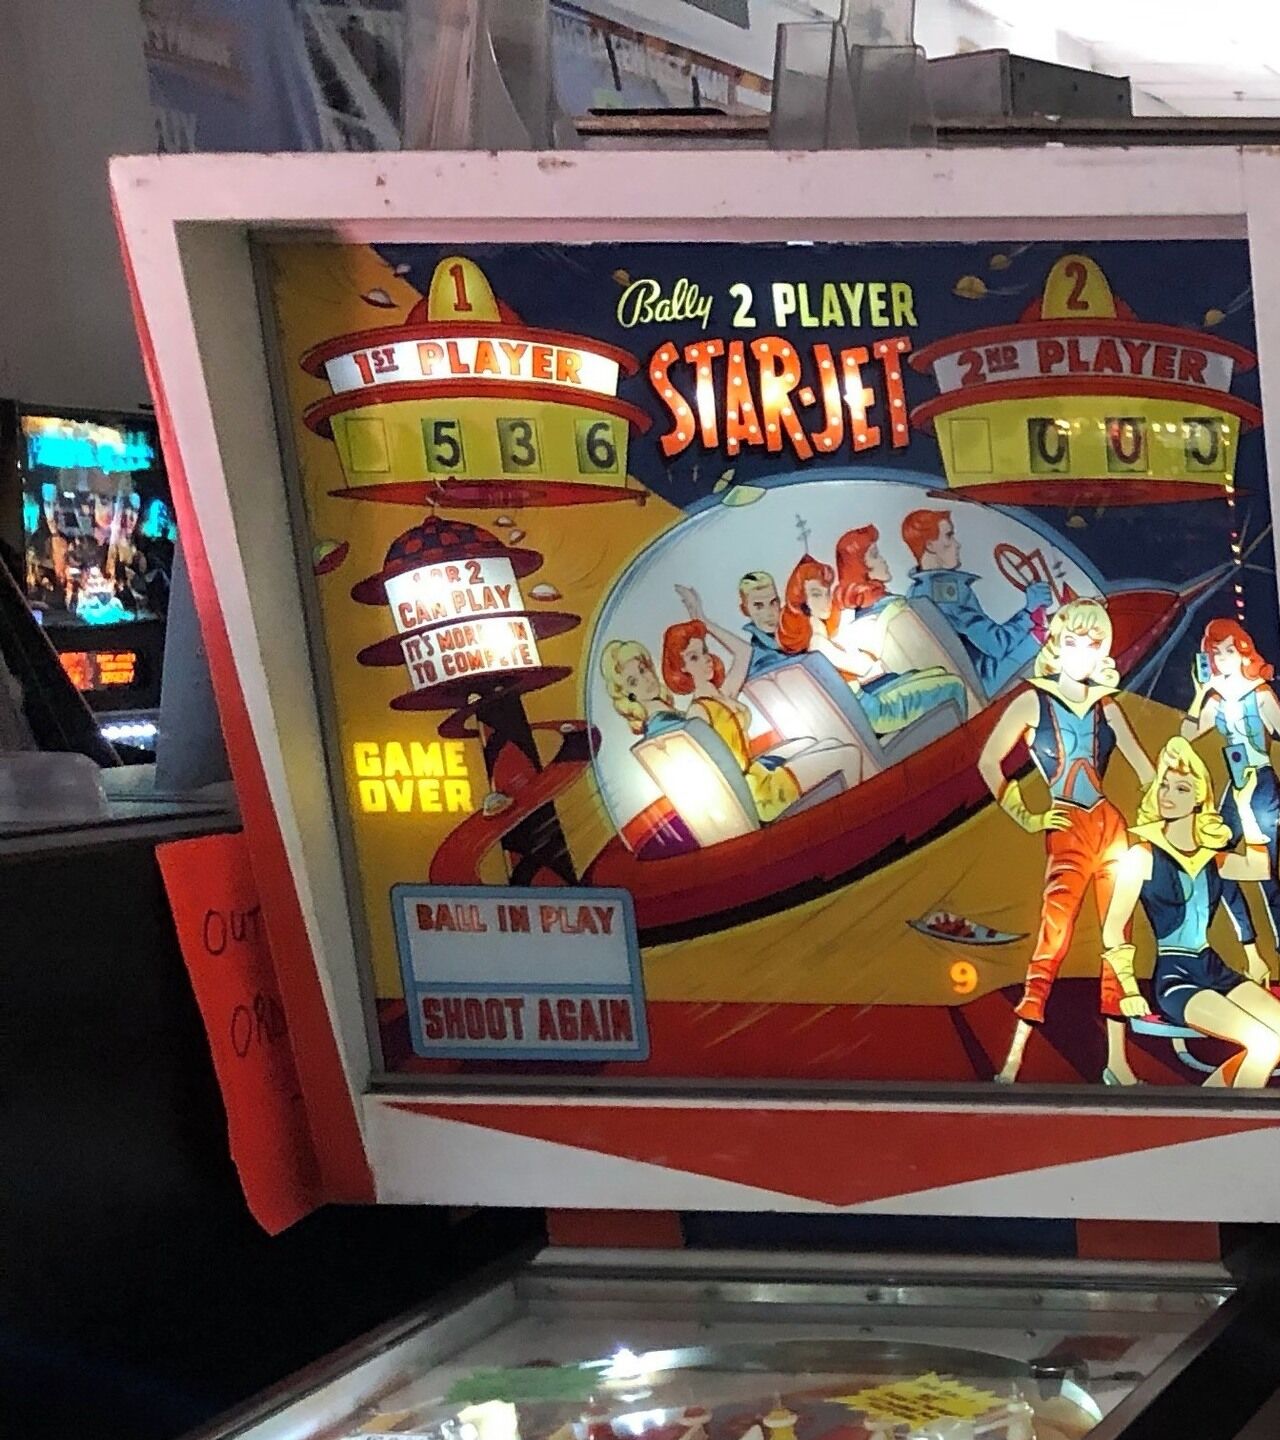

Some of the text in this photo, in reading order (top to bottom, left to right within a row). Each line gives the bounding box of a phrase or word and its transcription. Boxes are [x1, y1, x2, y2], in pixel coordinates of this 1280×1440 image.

[450, 264, 472, 312] 1
[617, 278, 918, 329] Bally 2 PLAYER
[1065, 263, 1089, 311] 2
[353, 340, 583, 385] 1ST PLAYER
[956, 339, 1208, 387] 2ND PLAYER
[465, 560, 485, 585] 2
[453, 584, 511, 614] PLAY
[412, 660, 438, 684] TO
[353, 742, 469, 777] GAME
[358, 779, 475, 812] OVER
[205, 905, 261, 955] OUT
[415, 903, 615, 934] BALL IN PLAY
[949, 961, 978, 994] 9
[422, 997, 634, 1042] SHOOT AGAIN
